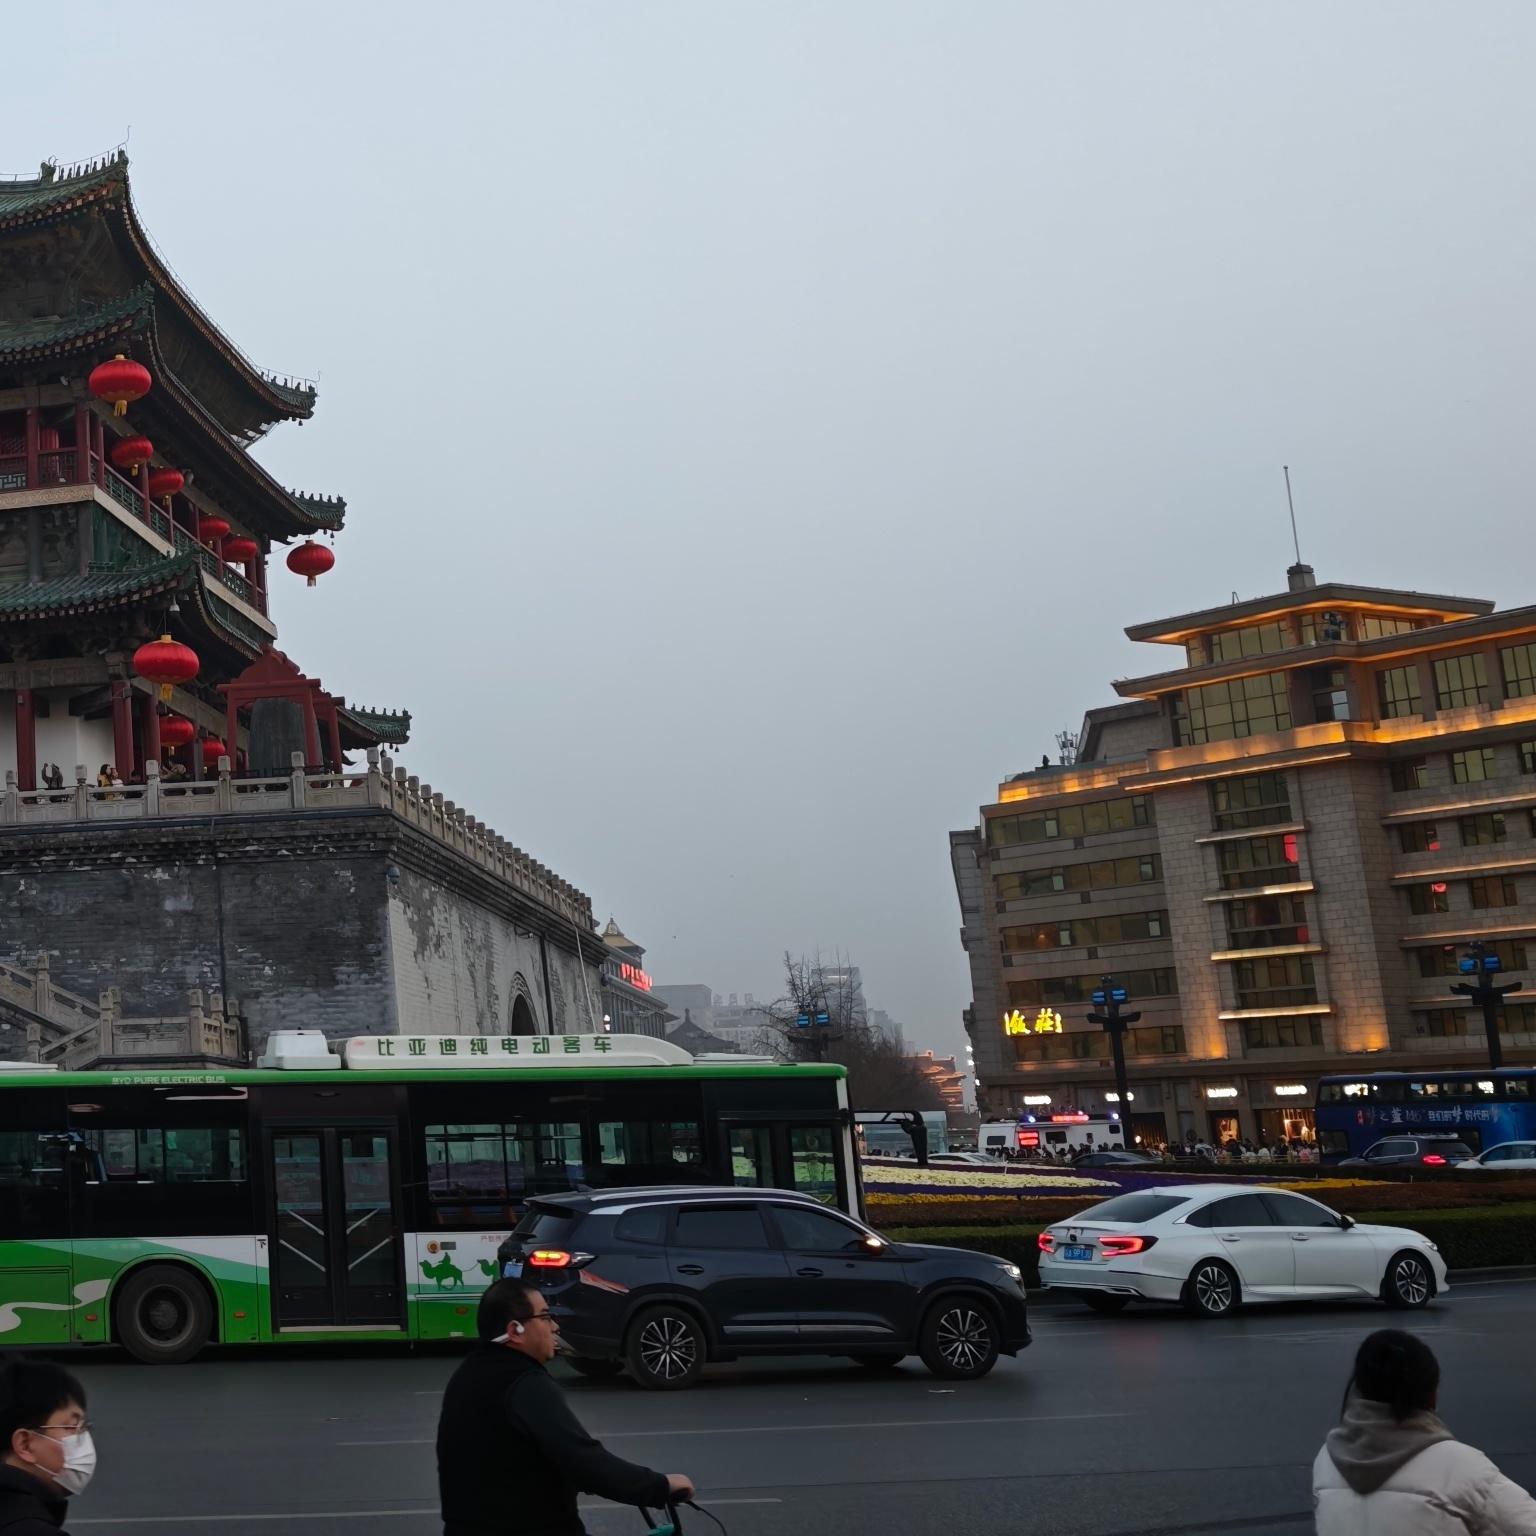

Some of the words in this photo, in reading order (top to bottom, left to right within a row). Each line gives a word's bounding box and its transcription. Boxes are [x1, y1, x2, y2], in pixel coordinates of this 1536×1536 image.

[376, 1035, 613, 1057] 比亚迪纯电动客车
[134, 1076, 160, 1085] PURE
[161, 1075, 204, 1084] ELECTRIC
[205, 1075, 226, 1084] BUS
